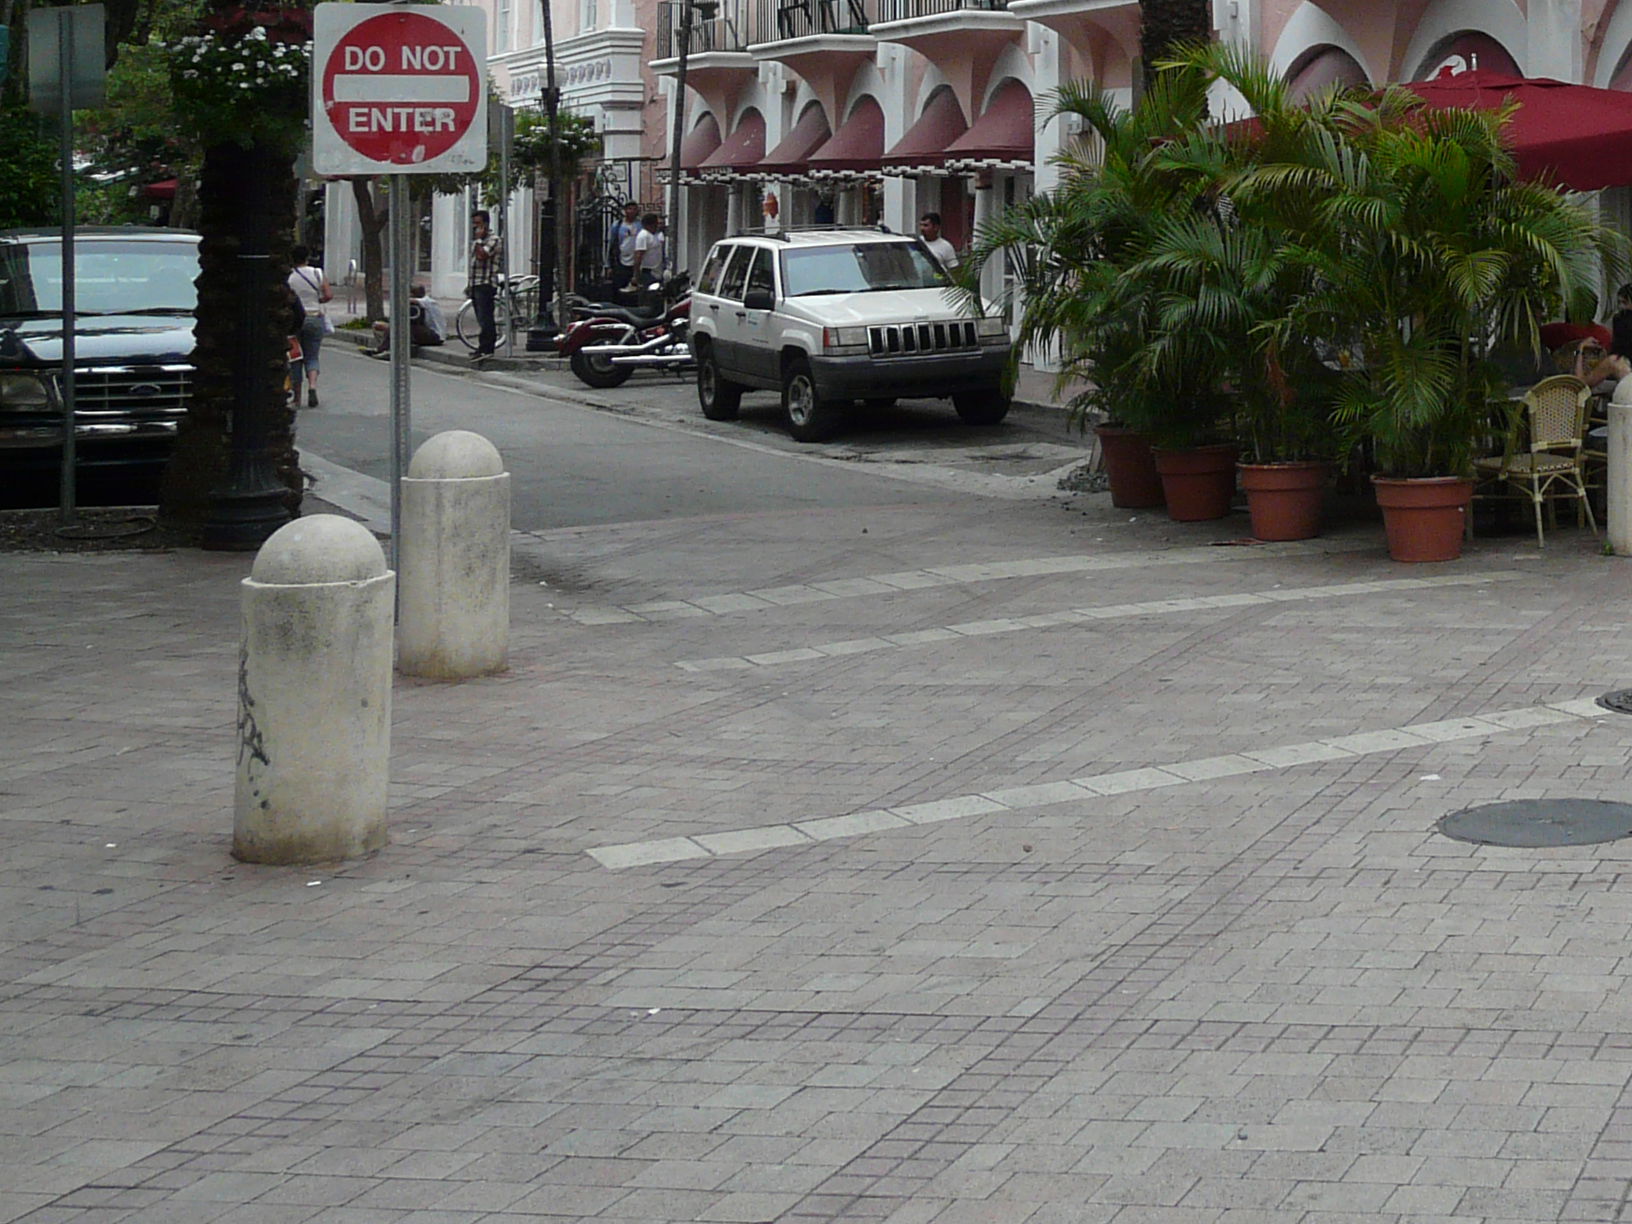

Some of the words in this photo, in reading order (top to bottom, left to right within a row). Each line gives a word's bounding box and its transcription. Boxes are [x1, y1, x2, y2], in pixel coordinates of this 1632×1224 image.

[344, 45, 386, 72] DO
[401, 45, 462, 71] NOT
[348, 107, 456, 132] ENTER
